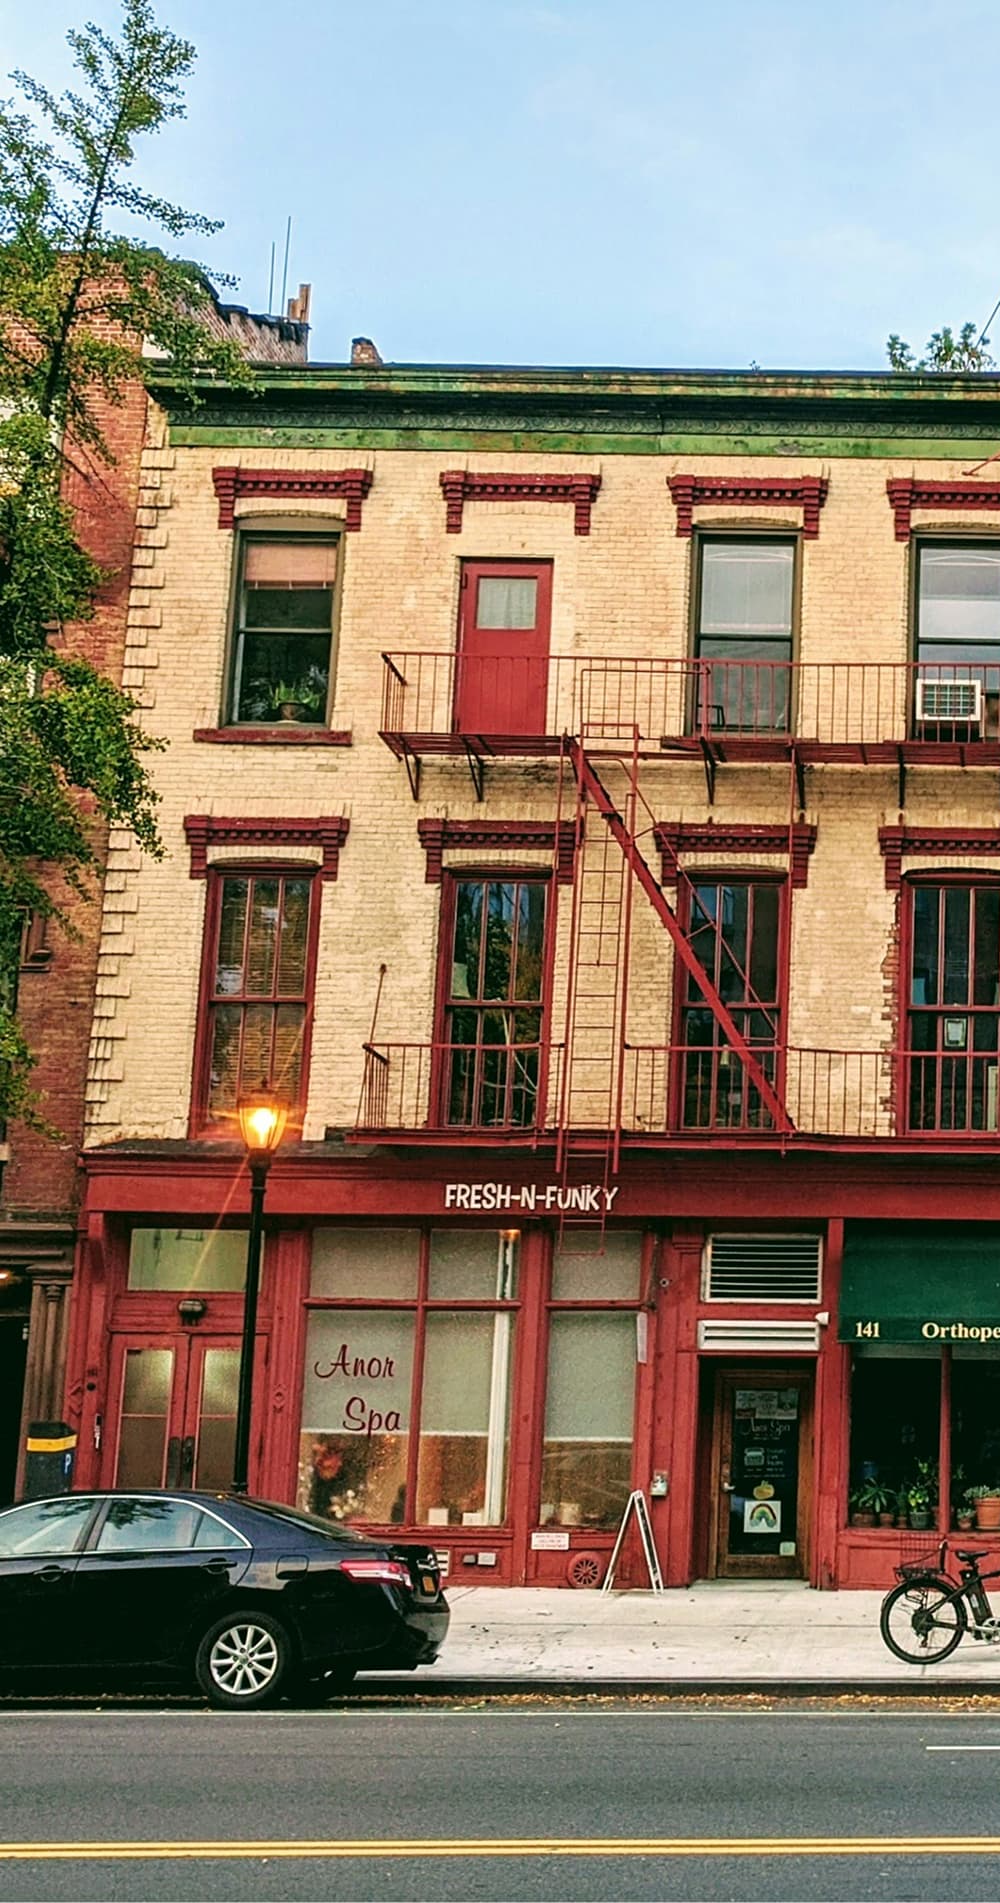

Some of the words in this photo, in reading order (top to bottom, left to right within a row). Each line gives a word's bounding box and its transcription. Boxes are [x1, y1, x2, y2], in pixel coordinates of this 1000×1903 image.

[445, 1183, 618, 1211] FRESH-N-FUNKY
[855, 1321, 880, 1338] 141
[314, 1344, 394, 1378] Anor
[342, 1396, 400, 1439] Spa
